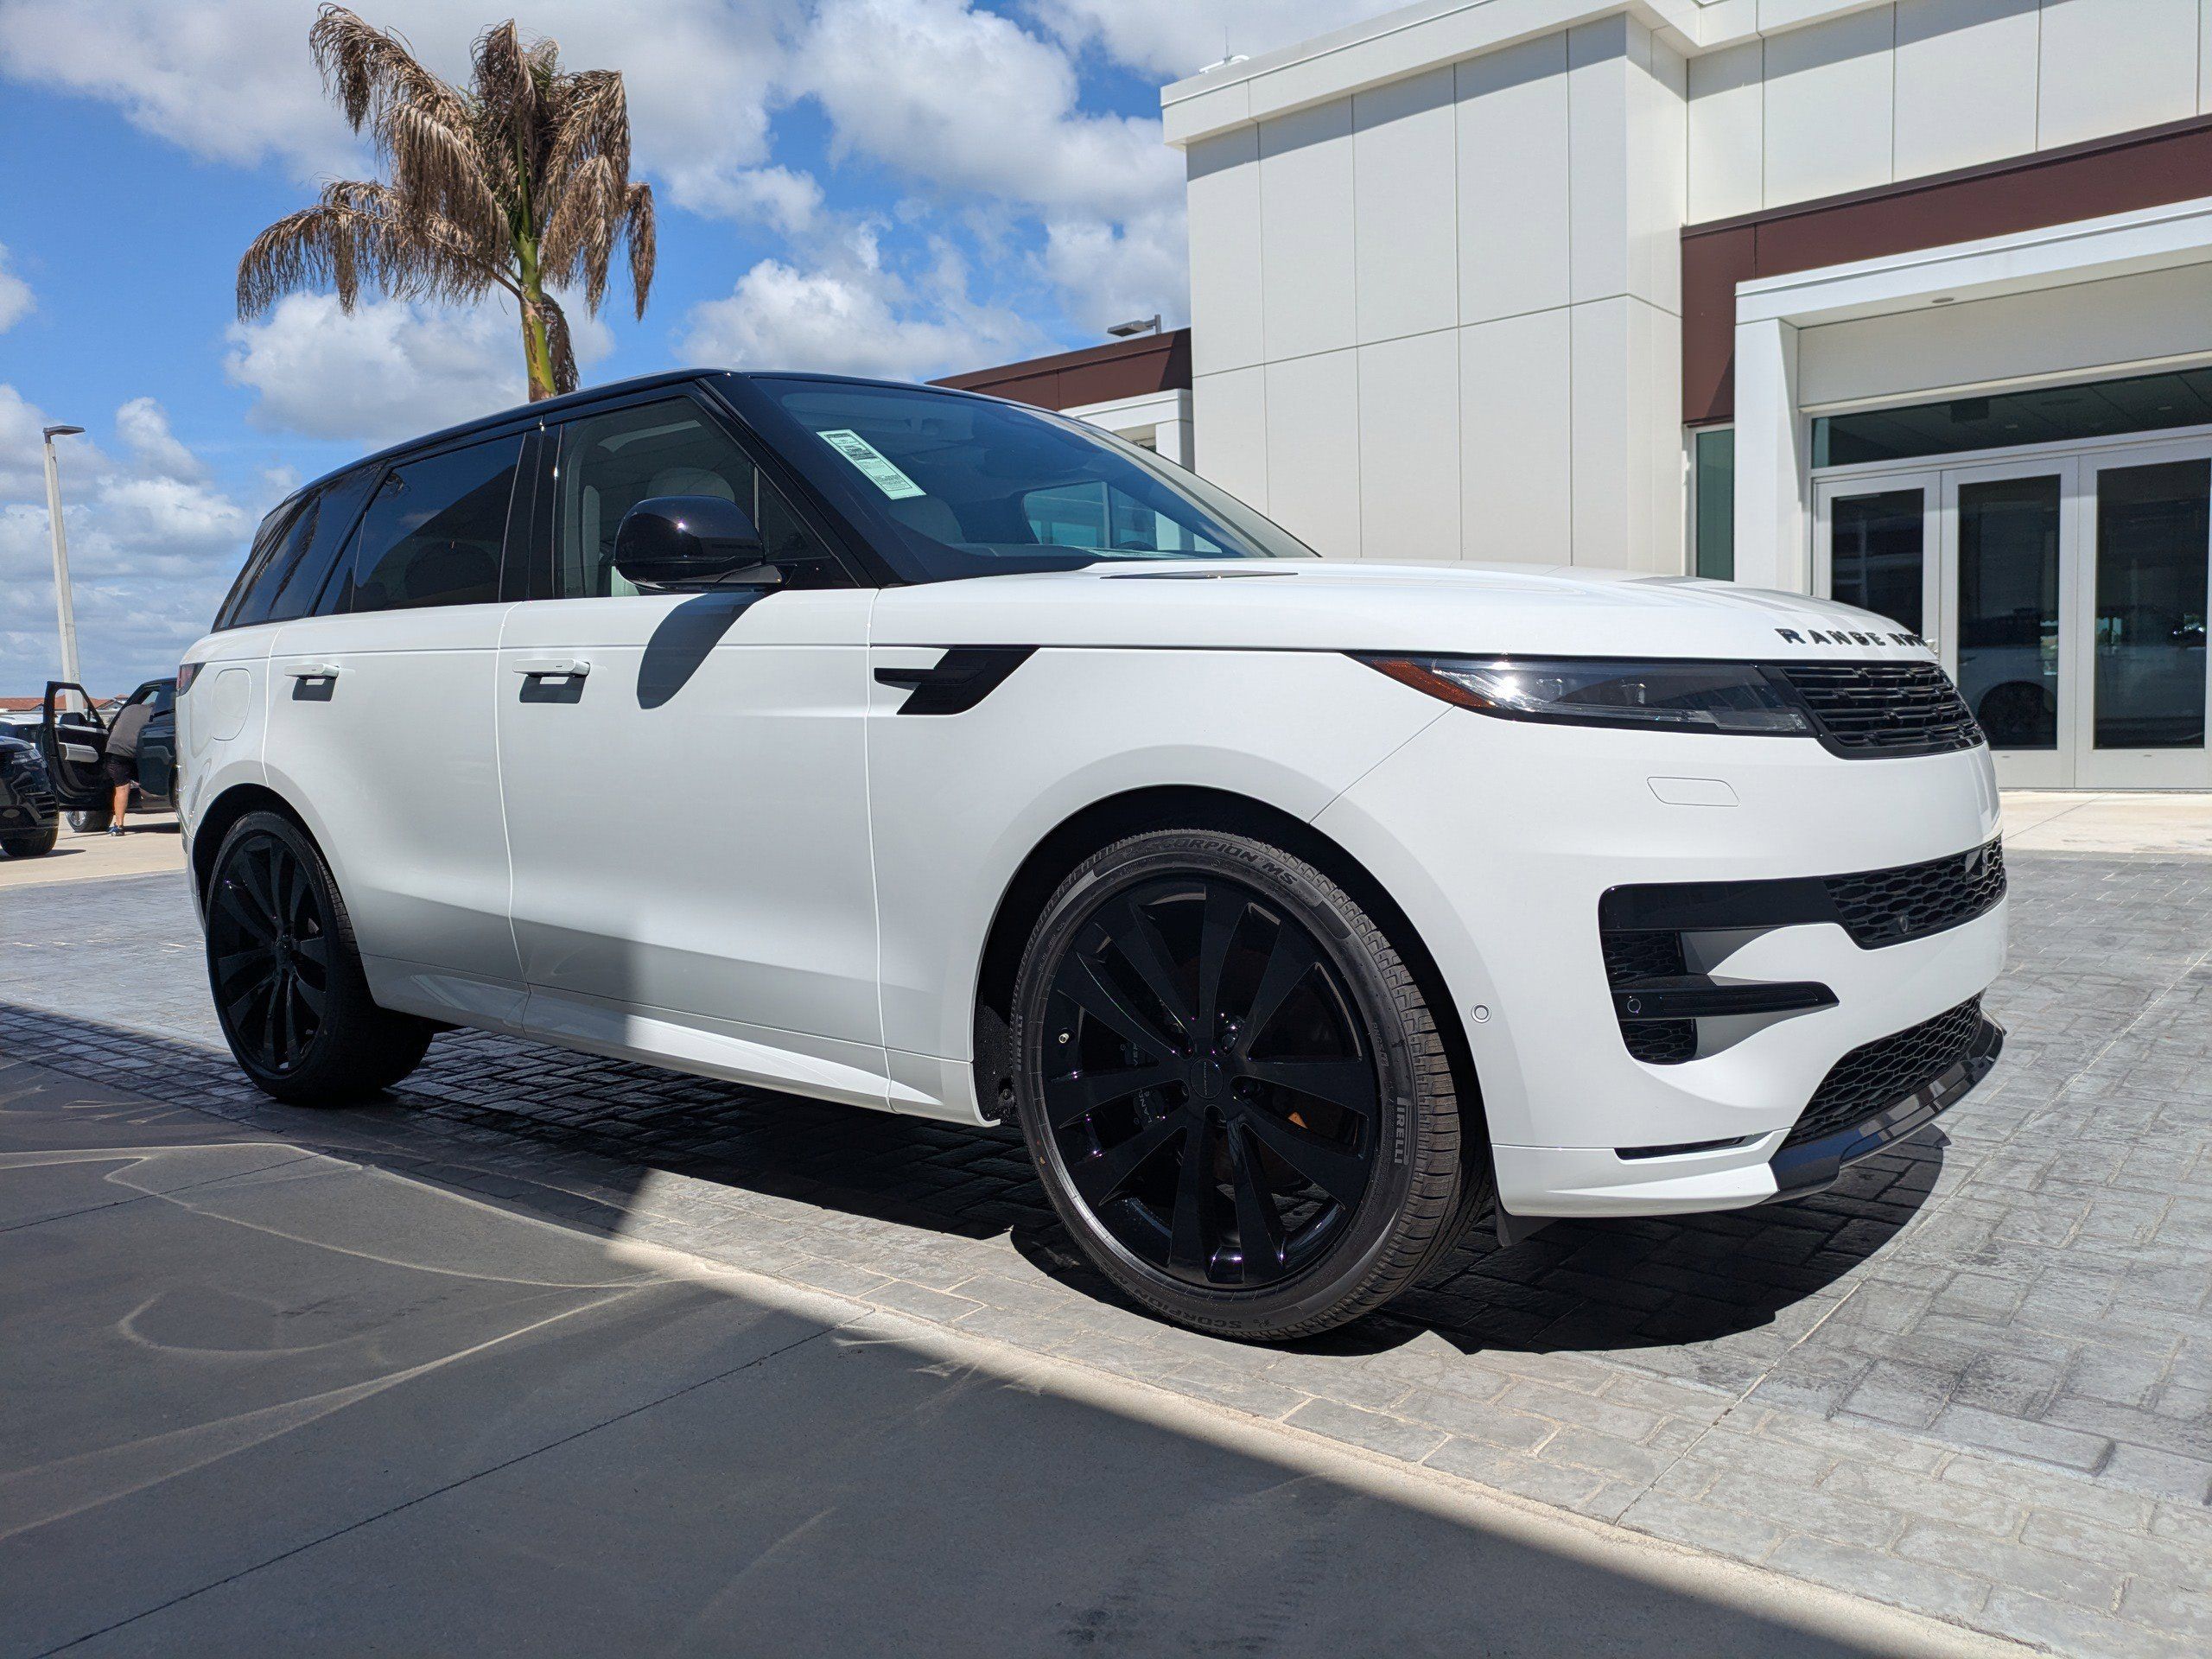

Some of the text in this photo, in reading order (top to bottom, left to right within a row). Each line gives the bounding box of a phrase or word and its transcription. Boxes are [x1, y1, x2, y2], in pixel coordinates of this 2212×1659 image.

[1774, 628, 1886, 646] RANGE
[1262, 861, 1298, 885] MS
[1394, 1096, 1412, 1166] PIRELLI
